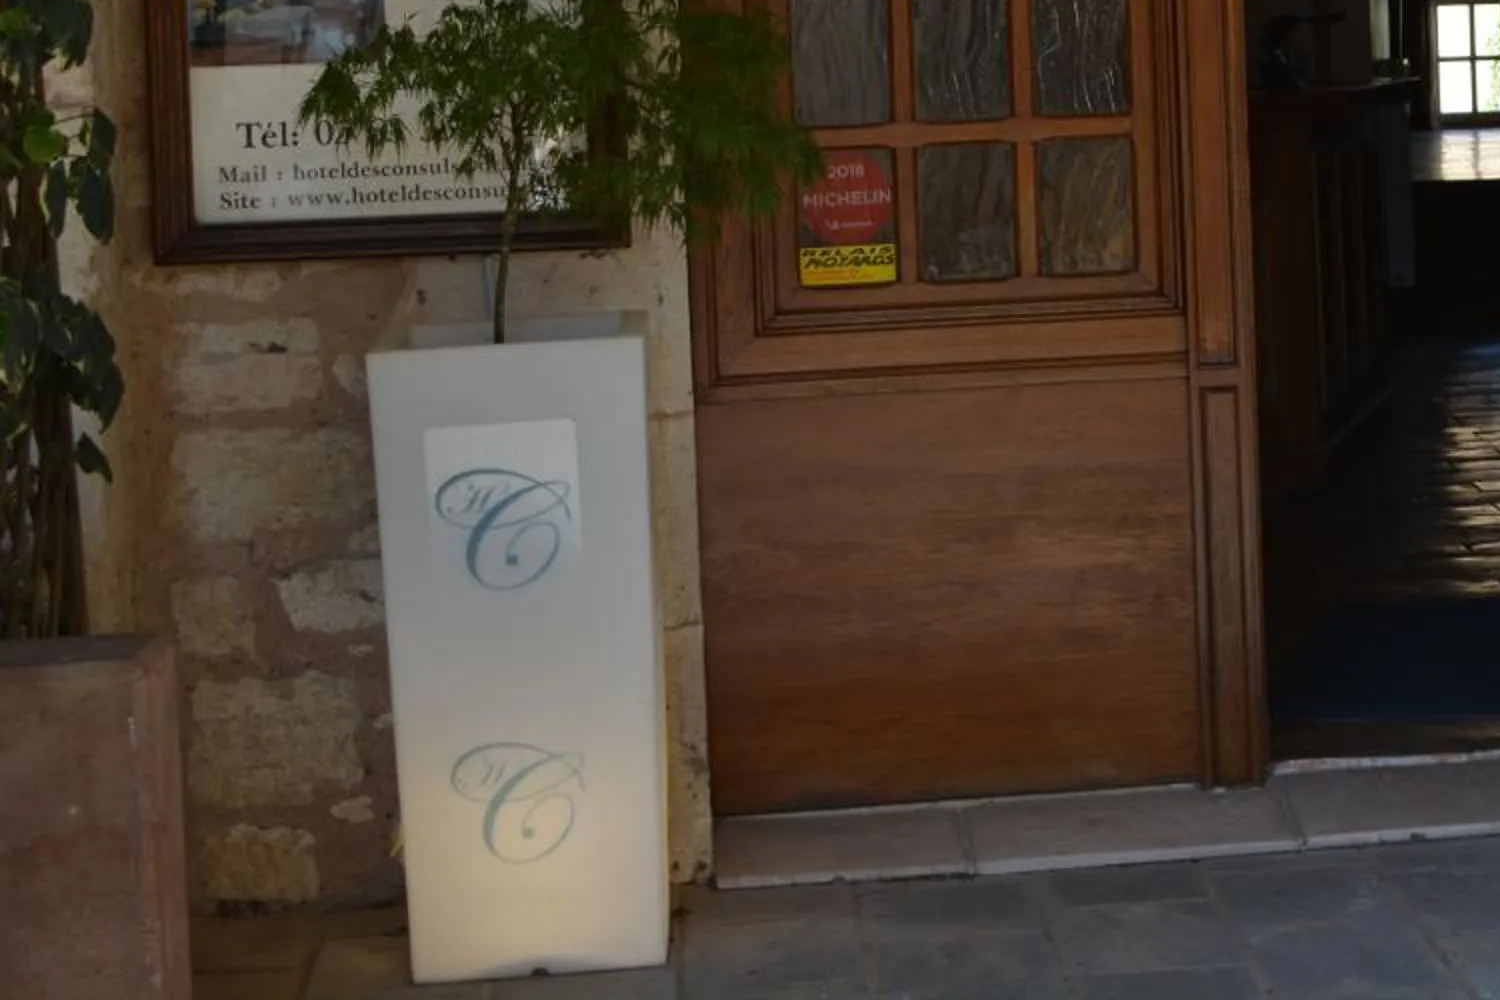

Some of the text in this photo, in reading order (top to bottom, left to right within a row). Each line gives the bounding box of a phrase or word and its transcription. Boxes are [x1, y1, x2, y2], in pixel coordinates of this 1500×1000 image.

[236, 120, 300, 149] Tél:
[219, 164, 267, 184] Mail
[219, 192, 262, 210] Site
[287, 184, 507, 207] www.hoteldesconsu
[803, 187, 892, 209] MICHELIN
